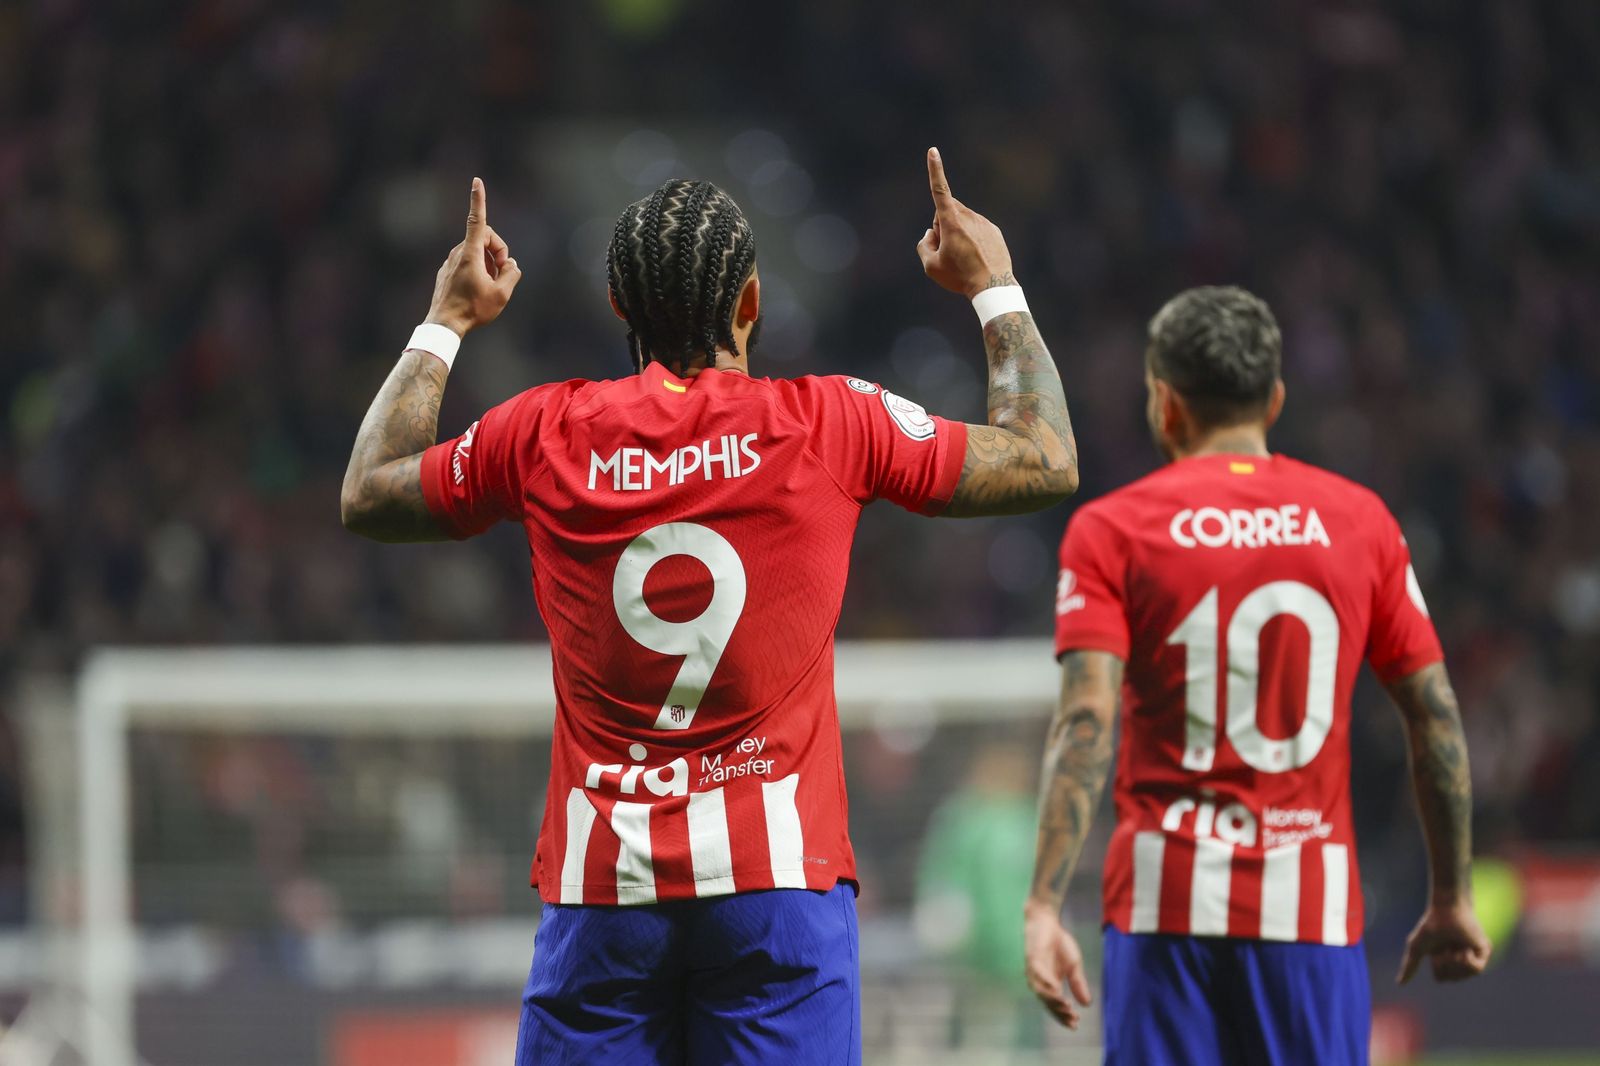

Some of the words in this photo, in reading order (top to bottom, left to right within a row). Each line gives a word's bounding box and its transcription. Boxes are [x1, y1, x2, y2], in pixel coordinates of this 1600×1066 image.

[588, 433, 761, 490] MEMPHIS
[1169, 504, 1331, 548] CORREA
[613, 522, 746, 729] 9
[1167, 580, 1340, 773] 10
[586, 743, 689, 797] ria
[1161, 788, 1257, 848] ria
